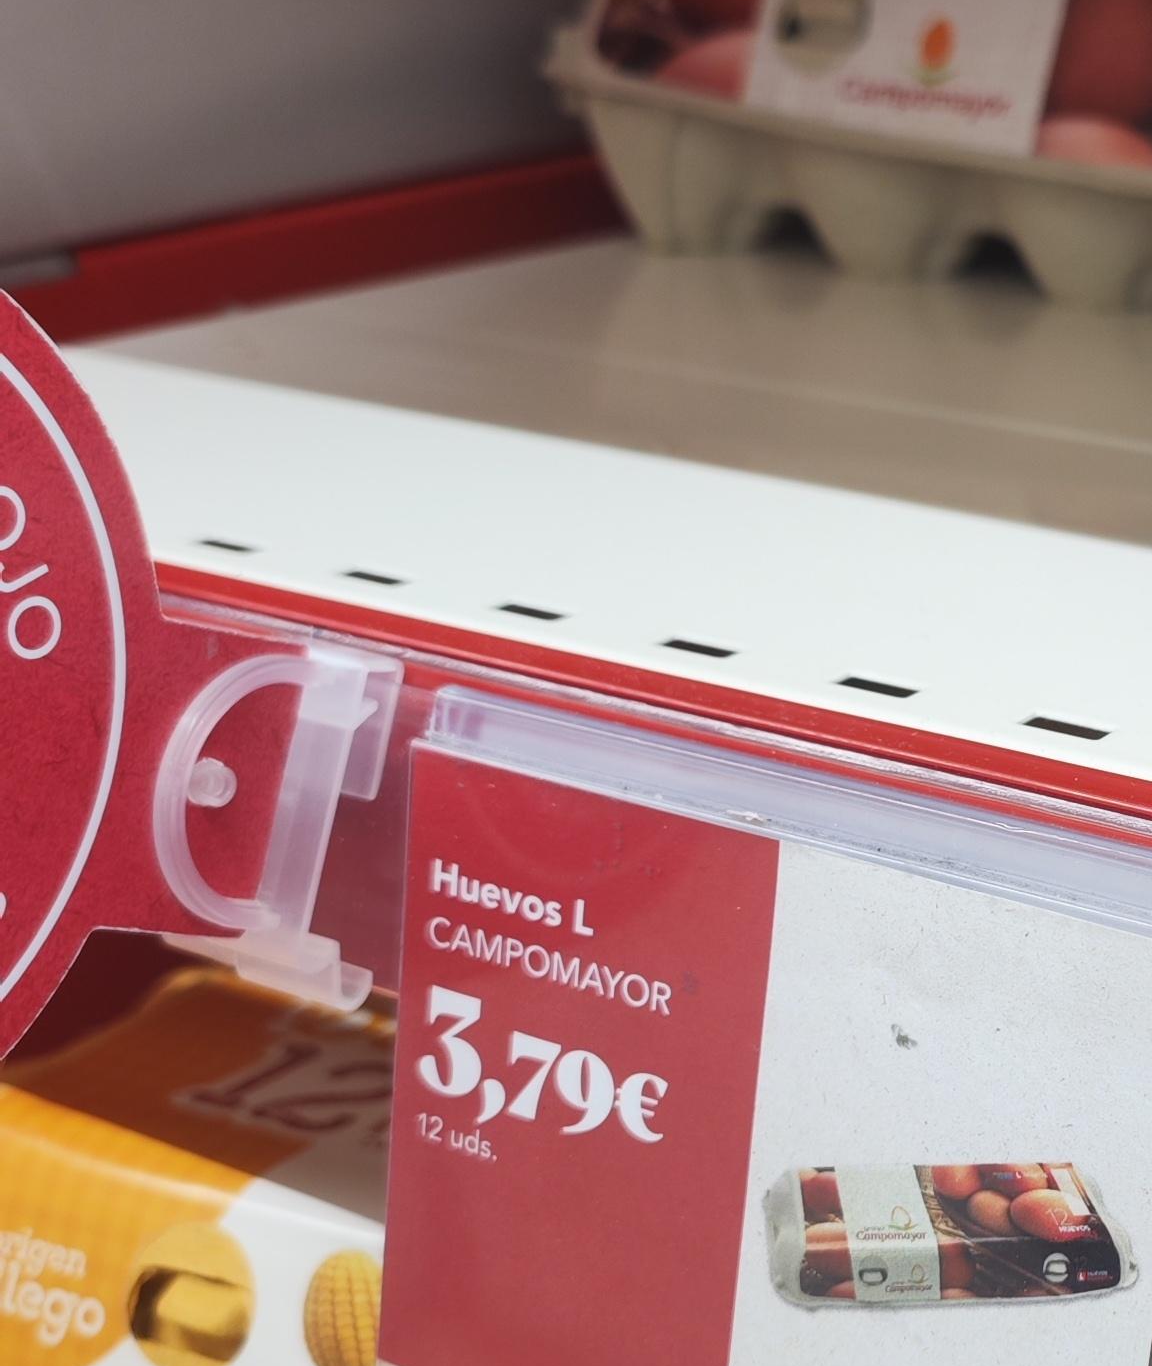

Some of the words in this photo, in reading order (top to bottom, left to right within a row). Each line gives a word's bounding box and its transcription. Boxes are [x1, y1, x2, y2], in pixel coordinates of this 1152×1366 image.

[431, 857, 562, 927] Huevos
[572, 899, 594, 936] L
[427, 916, 672, 1017] CAMPOMAYOR
[417, 984, 669, 1143] 3,79€
[417, 1112, 444, 1141] 12
[451, 1129, 498, 1162] uds.
